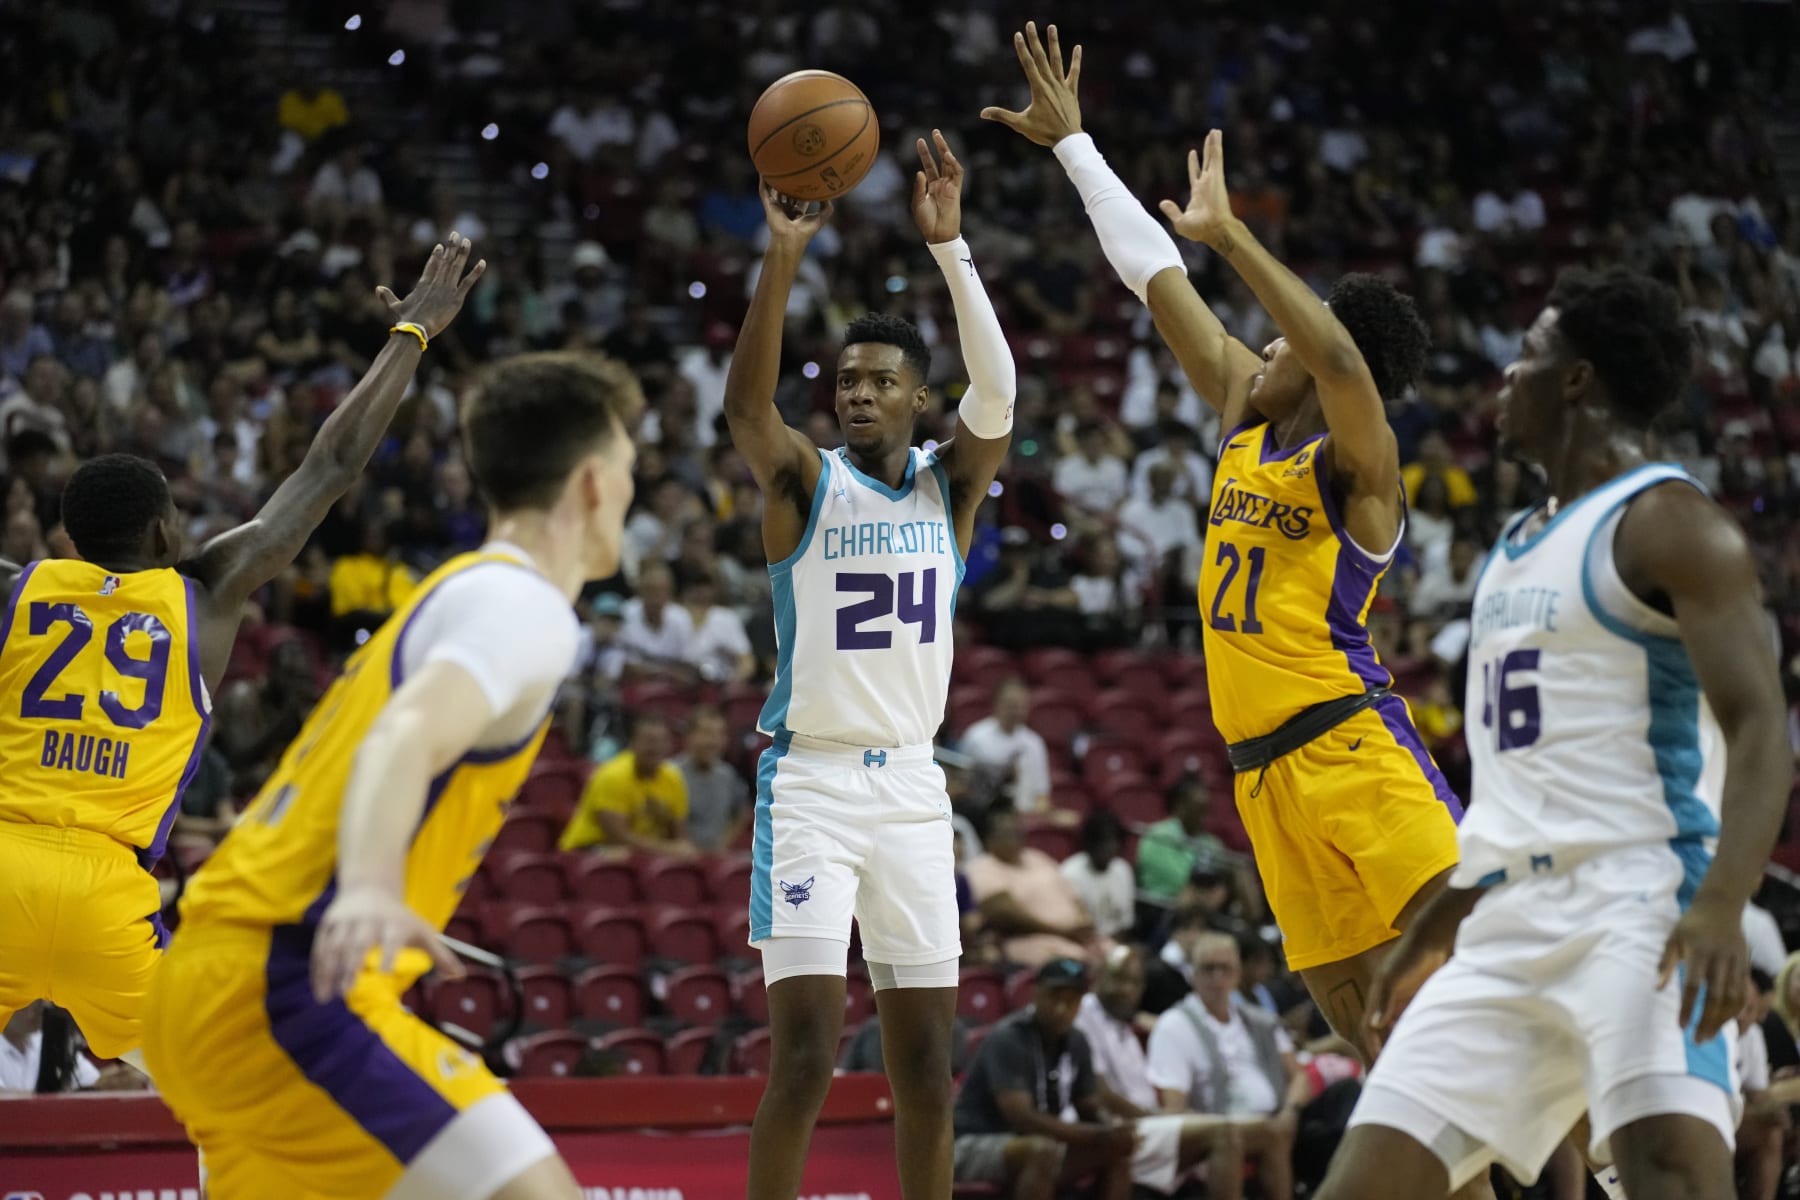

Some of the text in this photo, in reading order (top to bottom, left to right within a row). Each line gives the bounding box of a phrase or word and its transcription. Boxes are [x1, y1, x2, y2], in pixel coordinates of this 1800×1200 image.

[824, 521, 945, 560] CHARLOTTE
[1210, 478, 1313, 540] LAKERS
[835, 567, 937, 651] 24
[1210, 541, 1266, 634] 21
[20, 601, 172, 730] 29
[40, 729, 130, 779] BAUGH
